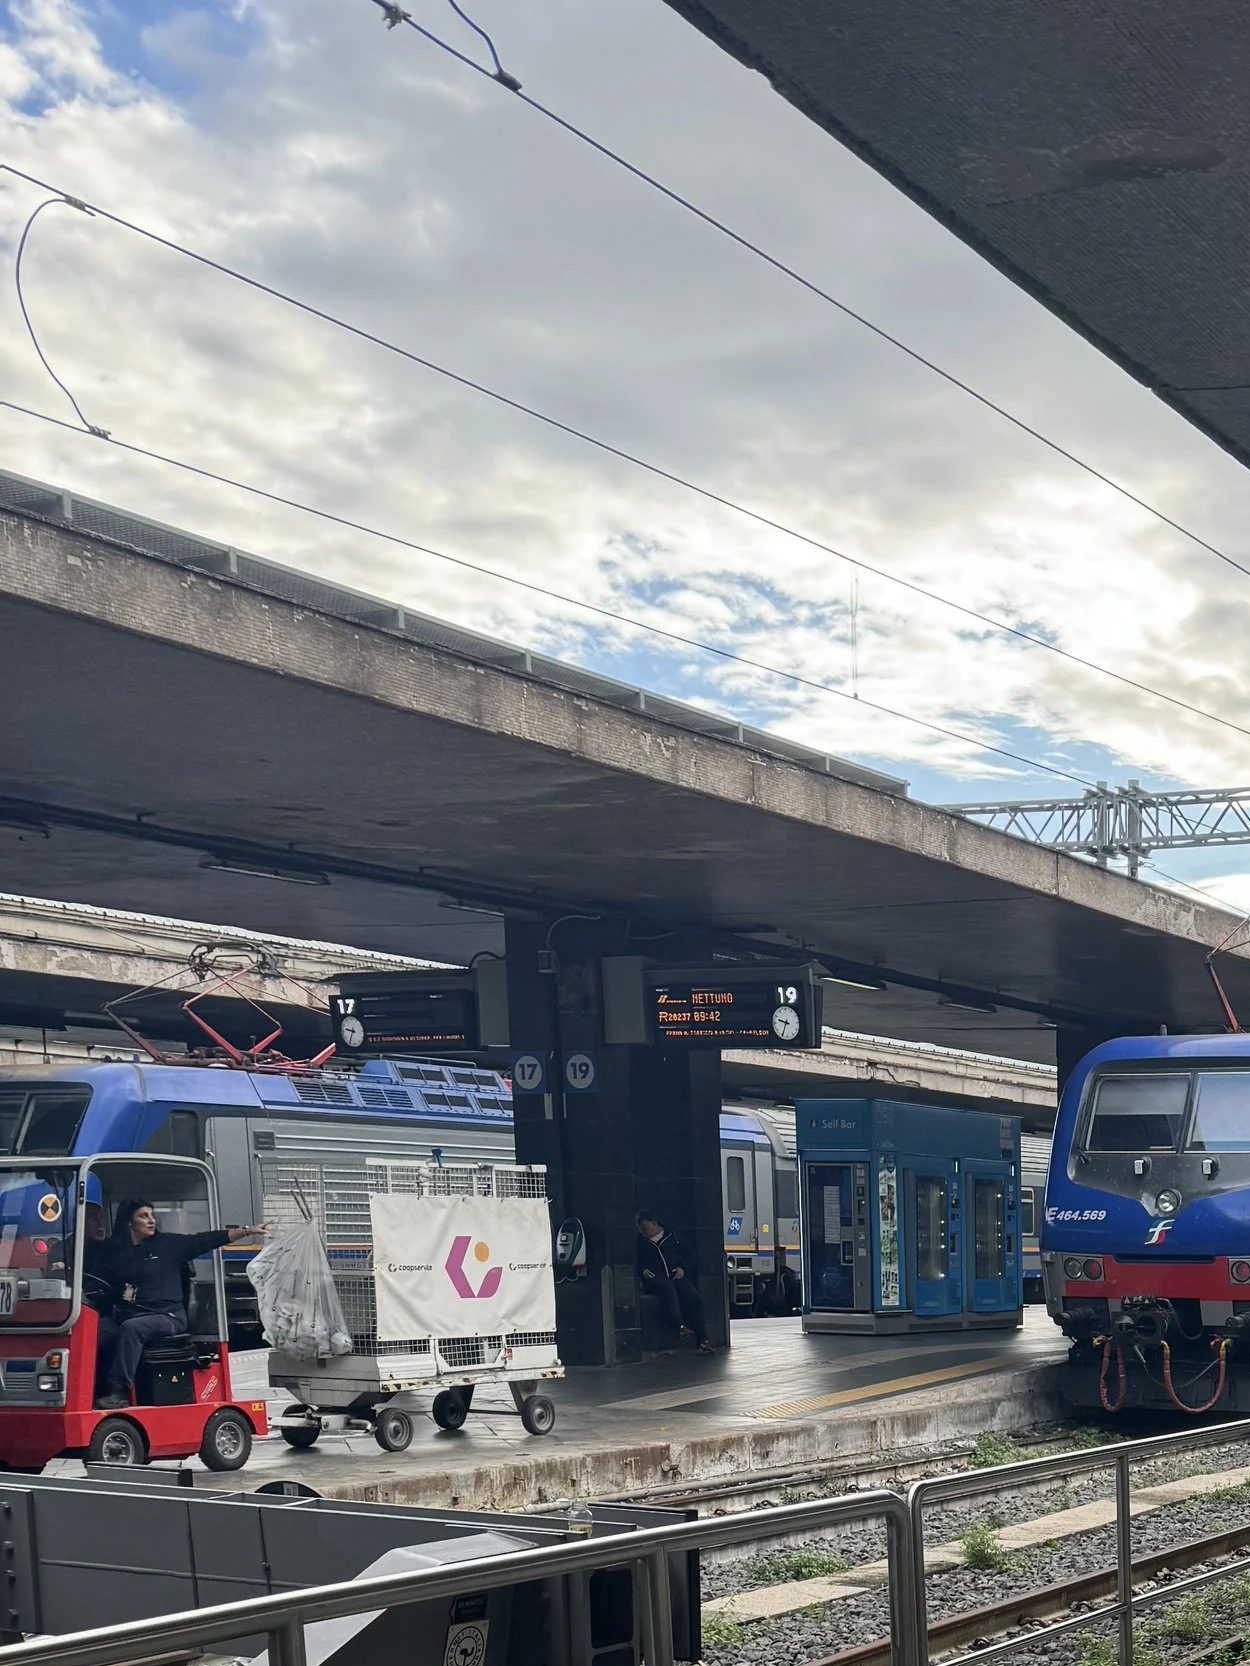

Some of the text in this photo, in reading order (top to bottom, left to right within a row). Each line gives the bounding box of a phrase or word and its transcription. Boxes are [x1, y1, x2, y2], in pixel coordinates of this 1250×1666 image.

[691, 992, 733, 1004] NETTUNO
[777, 986, 797, 1004] 19
[337, 999, 355, 1014] 17
[693, 1010, 721, 1022] 09:42
[519, 1063, 538, 1080] 17
[570, 1062, 590, 1079] 19
[822, 1119, 856, 1129] Self Bar
